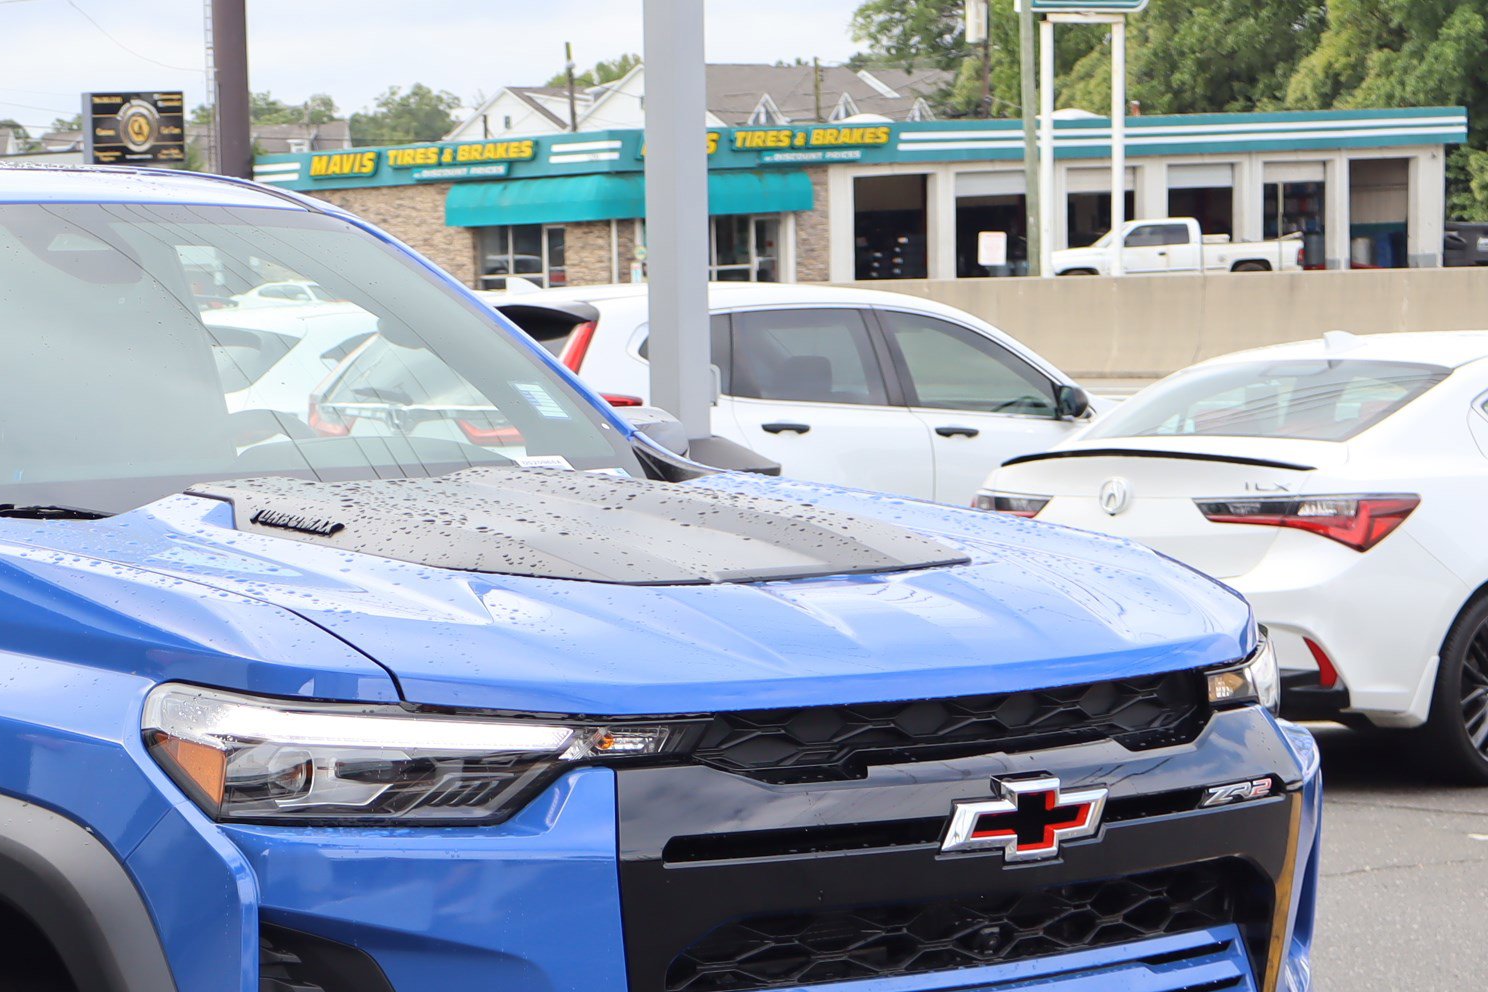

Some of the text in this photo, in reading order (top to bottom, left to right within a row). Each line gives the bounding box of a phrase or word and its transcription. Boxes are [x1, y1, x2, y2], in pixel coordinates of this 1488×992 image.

[734, 129, 793, 149] TIRES
[794, 132, 807, 147] &
[810, 126, 891, 146] BRAKES
[309, 140, 535, 177] MAVIS TIRES & BRAKES
[1245, 481, 1291, 492] ILX
[1203, 777, 1273, 807] ZR2
